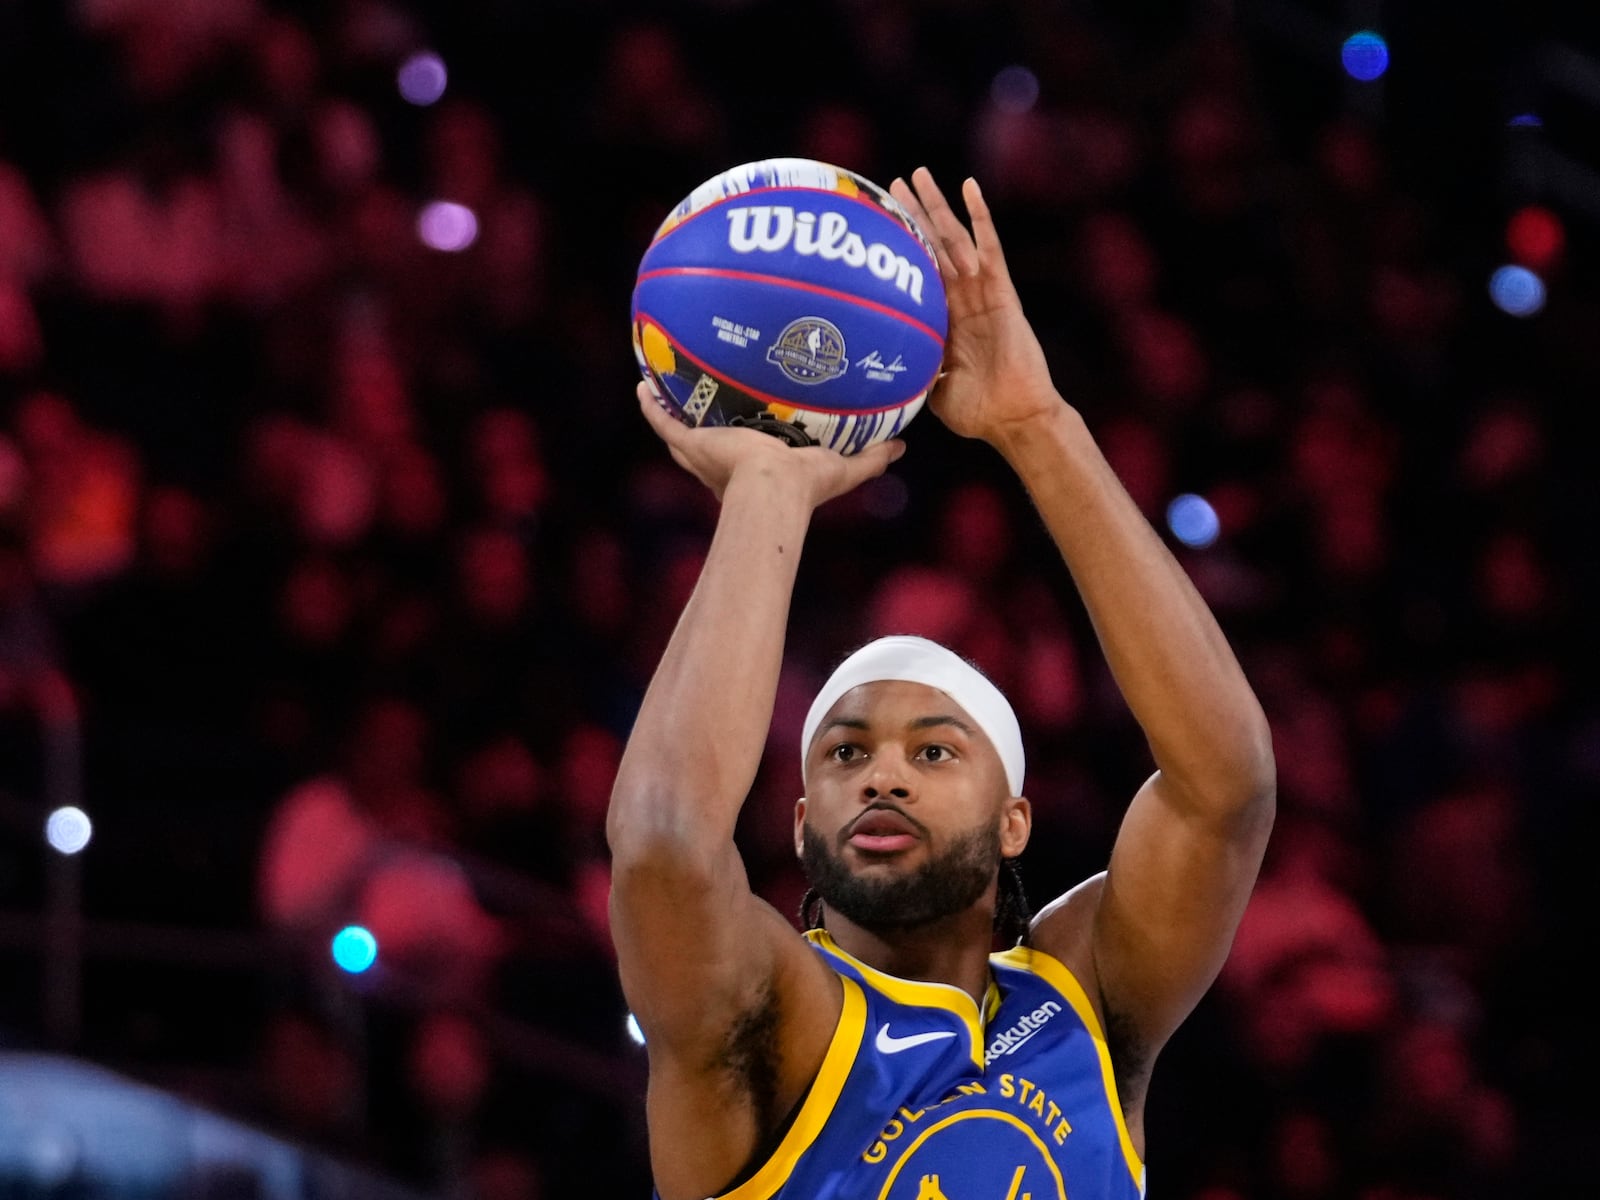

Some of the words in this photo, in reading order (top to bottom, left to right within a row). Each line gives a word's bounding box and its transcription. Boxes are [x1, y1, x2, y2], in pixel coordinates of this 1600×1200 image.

[727, 206, 924, 304] Wilson
[862, 1081, 987, 1164] GOLN
[999, 1072, 1073, 1146] STATE
